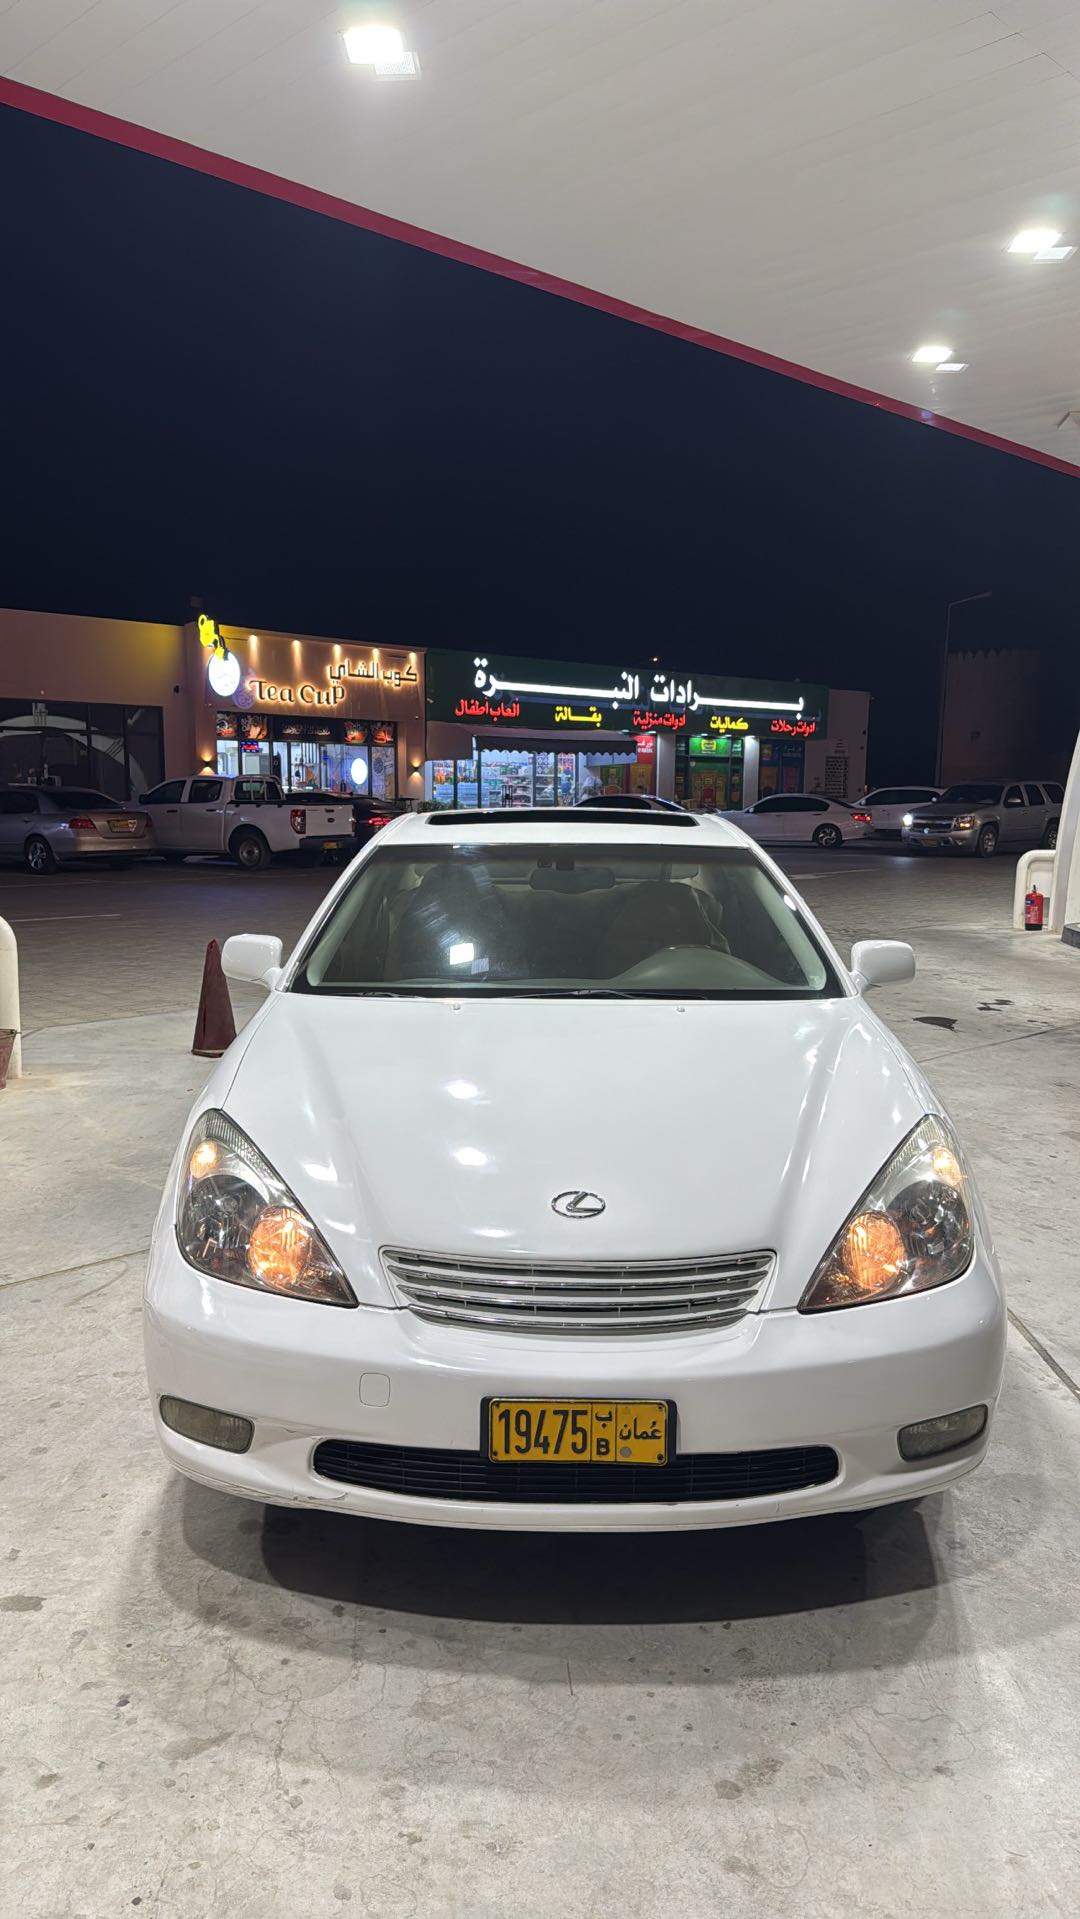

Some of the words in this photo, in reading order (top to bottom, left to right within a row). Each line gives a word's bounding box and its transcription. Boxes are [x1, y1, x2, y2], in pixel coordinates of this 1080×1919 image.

[329, 658, 380, 685] الشاي
[381, 665, 417, 688] كوب
[248, 680, 295, 703] Tea
[554, 705, 603, 728] بقالة
[633, 710, 663, 731] منزلية
[710, 715, 749, 734] كماليات
[770, 719, 797, 737] رحلات
[595, 1409, 613, 1428] ب
[498, 1408, 588, 1455] 19475
[596, 1437, 611, 1456] B
